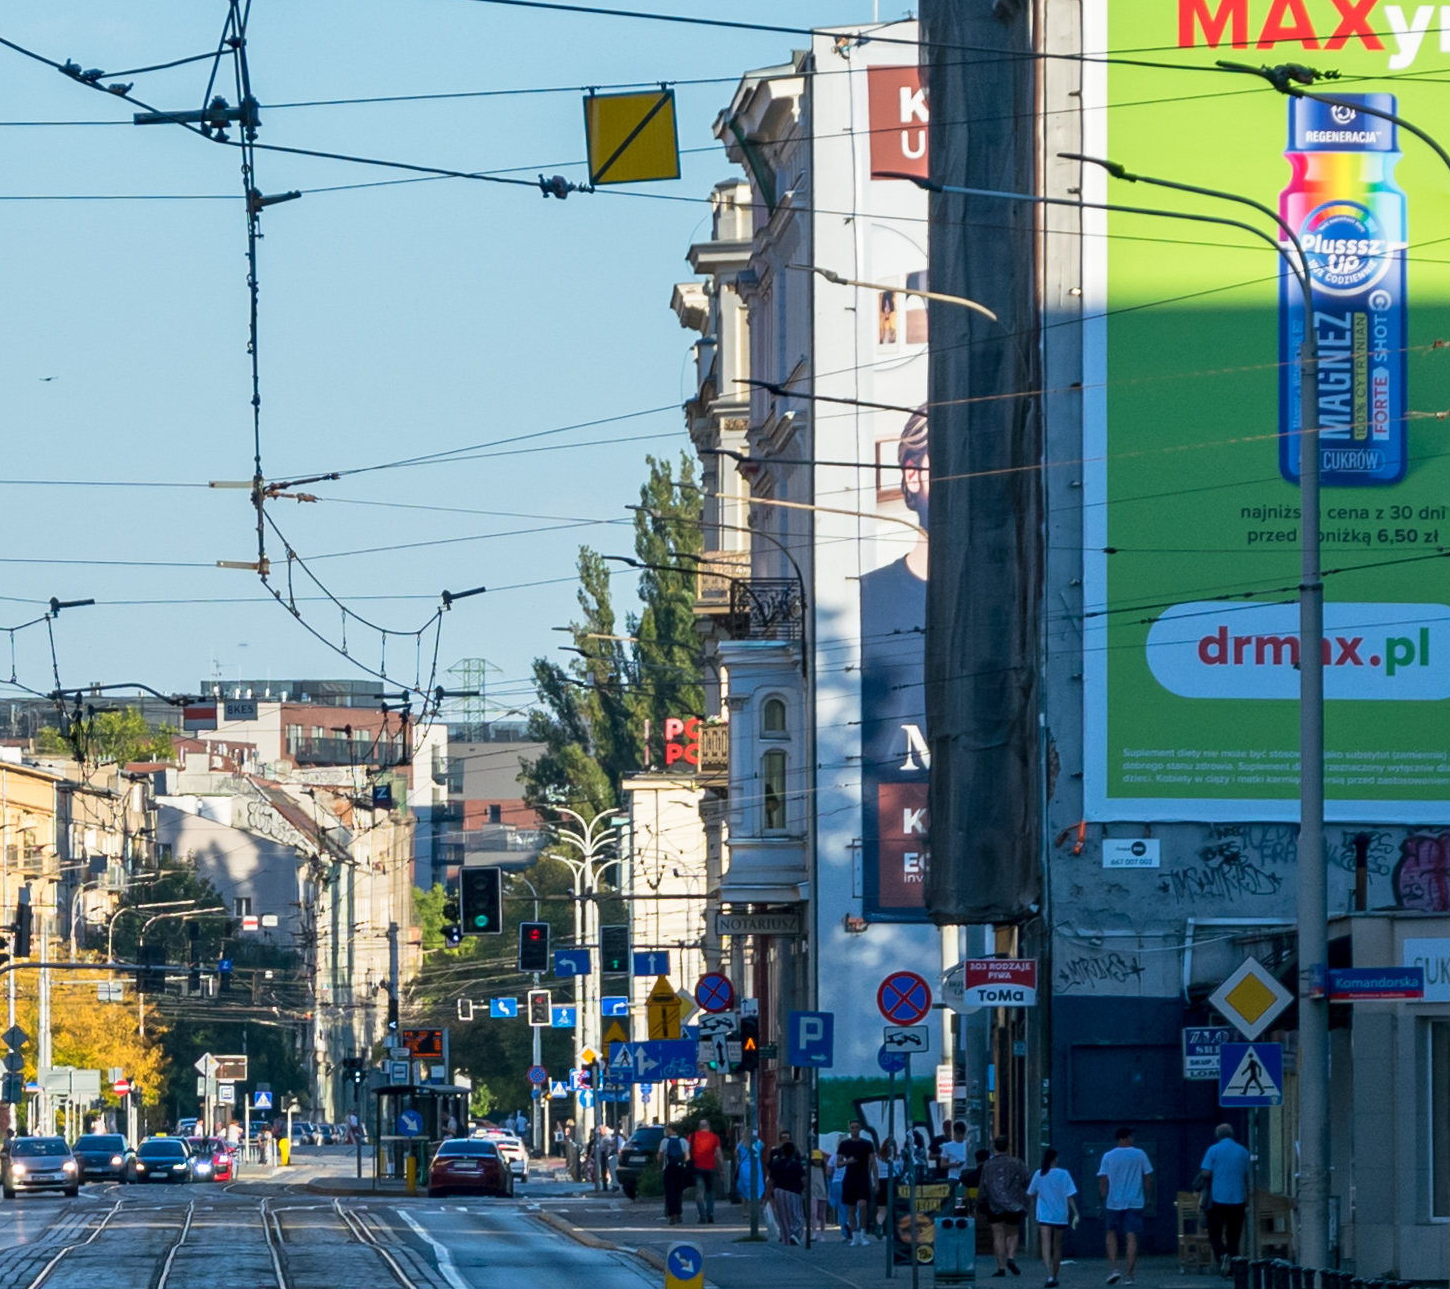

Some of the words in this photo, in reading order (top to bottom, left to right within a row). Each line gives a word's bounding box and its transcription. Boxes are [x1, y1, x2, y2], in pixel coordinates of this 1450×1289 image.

[1374, 314, 1387, 362] SHOT
[1355, 316, 1366, 398] CYTRYNIAN
[1314, 311, 1351, 440] MAGNEZ
[1374, 376, 1388, 433] FORTE
[1323, 448, 1379, 470] CUKRÓW
[1327, 509, 1369, 520] cena
[1375, 509, 1384, 519] z
[1390, 506, 1413, 520] 30
[1419, 506, 1446, 520] dni
[1248, 528, 1297, 545] przed
[1377, 528, 1418, 545] 6,50
[1424, 529, 1439, 543] zł
[719, 918, 798, 931] NOTARIUSZ
[988, 971, 1012, 979] PIWA
[989, 962, 1032, 971] RODZAJE
[1335, 975, 1419, 990] Komandorska
[977, 989, 1024, 1002] ToMa
[799, 1016, 824, 1050] P
